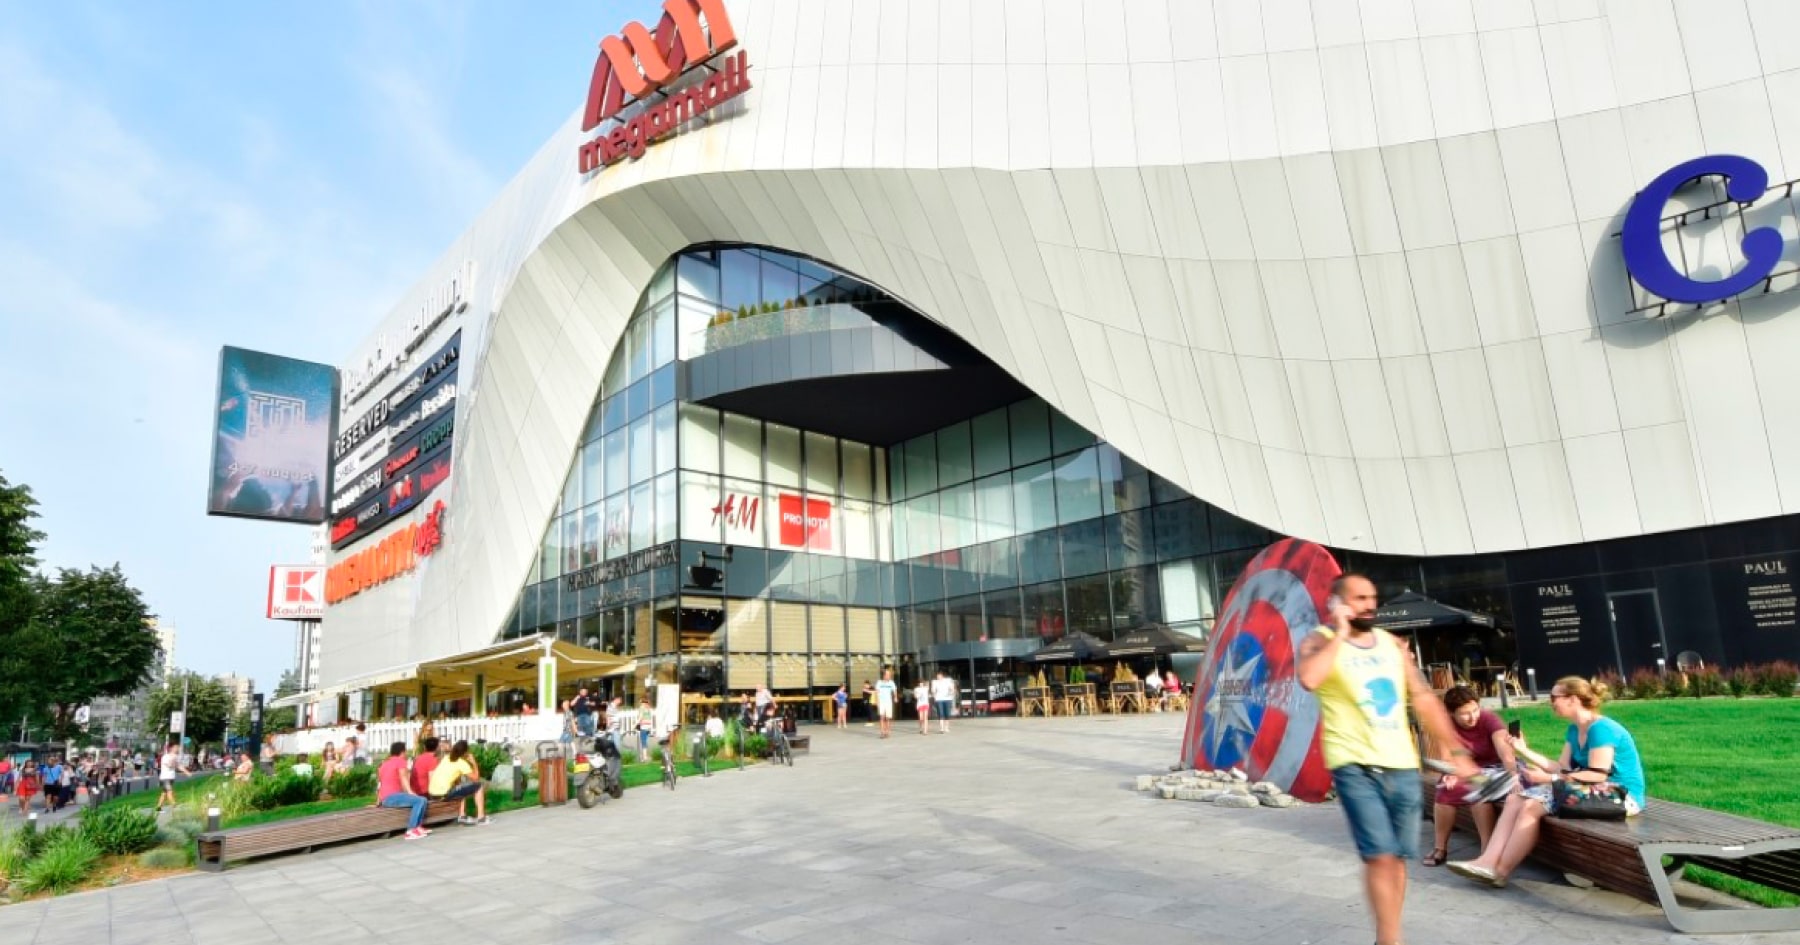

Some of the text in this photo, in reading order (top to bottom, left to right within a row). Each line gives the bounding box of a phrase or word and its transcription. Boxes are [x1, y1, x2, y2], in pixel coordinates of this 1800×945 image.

[579, 49, 751, 173] megamall
[1622, 154, 1783, 304] C
[335, 399, 388, 460] RESERVED
[260, 468, 316, 482] august
[711, 493, 759, 534] H&M
[1744, 560, 1787, 575] PAUL
[1539, 584, 1573, 596] PAUL
